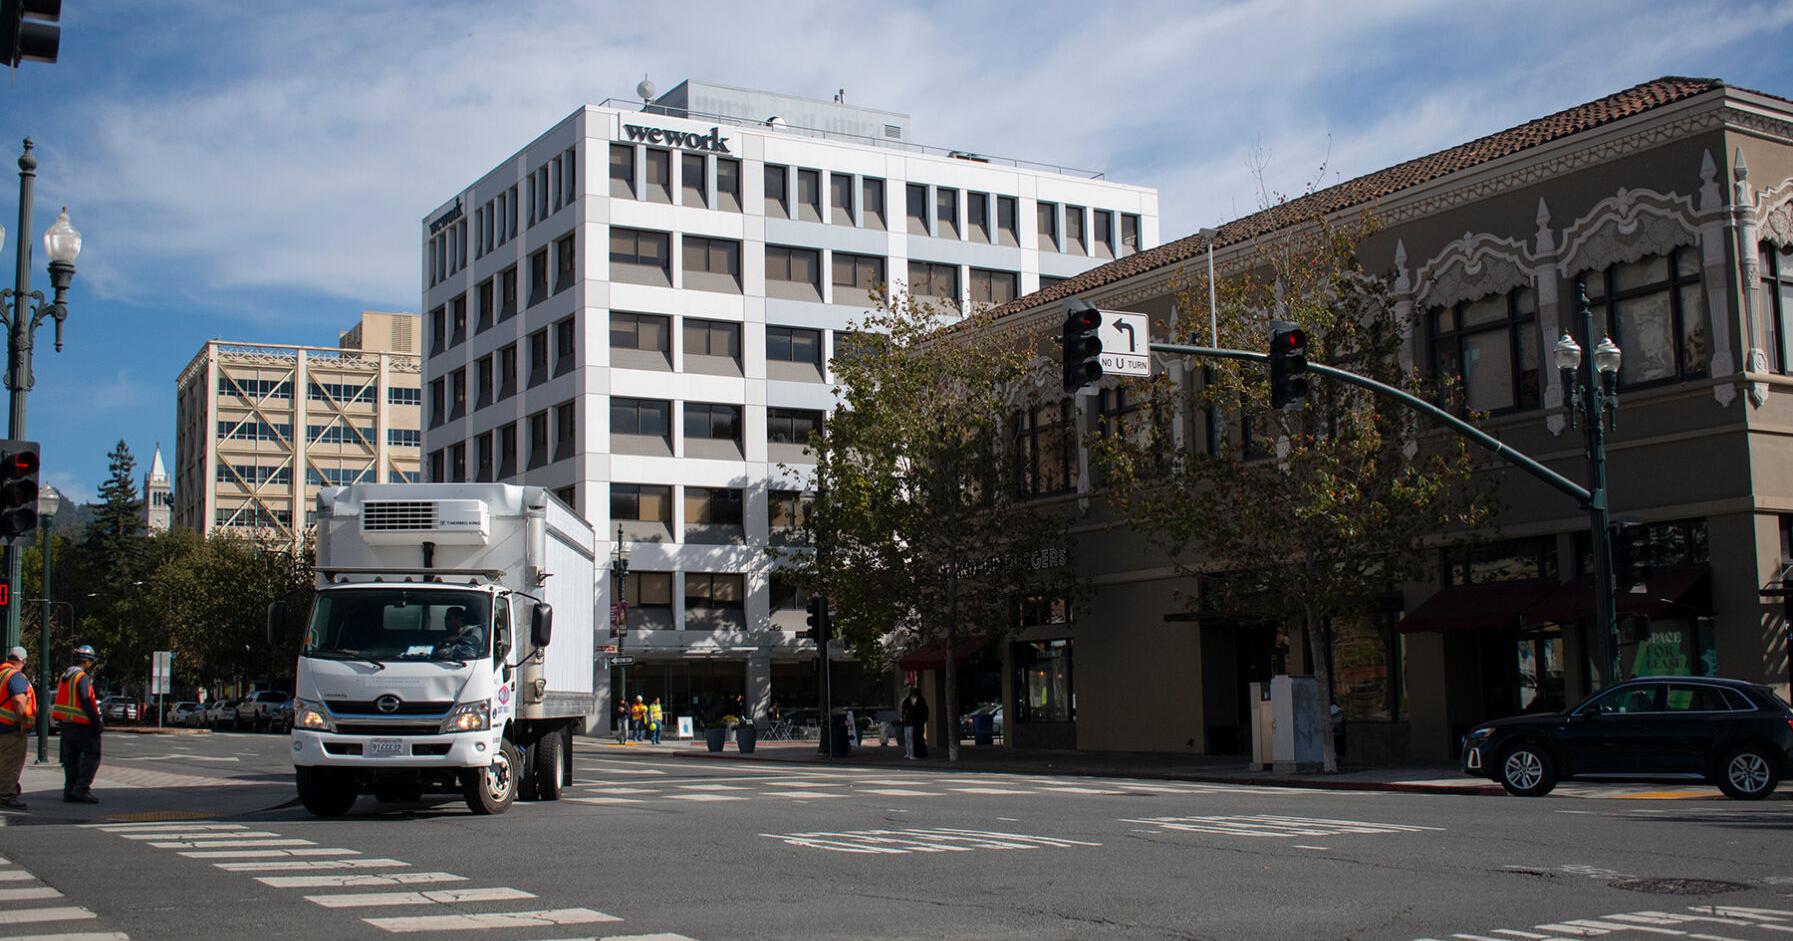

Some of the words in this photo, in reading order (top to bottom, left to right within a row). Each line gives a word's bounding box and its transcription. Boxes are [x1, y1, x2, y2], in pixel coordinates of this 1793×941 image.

[623, 124, 731, 153] wework
[1101, 358, 1112, 368] NO
[1115, 357, 1125, 370] U
[1127, 360, 1147, 370] TURN
